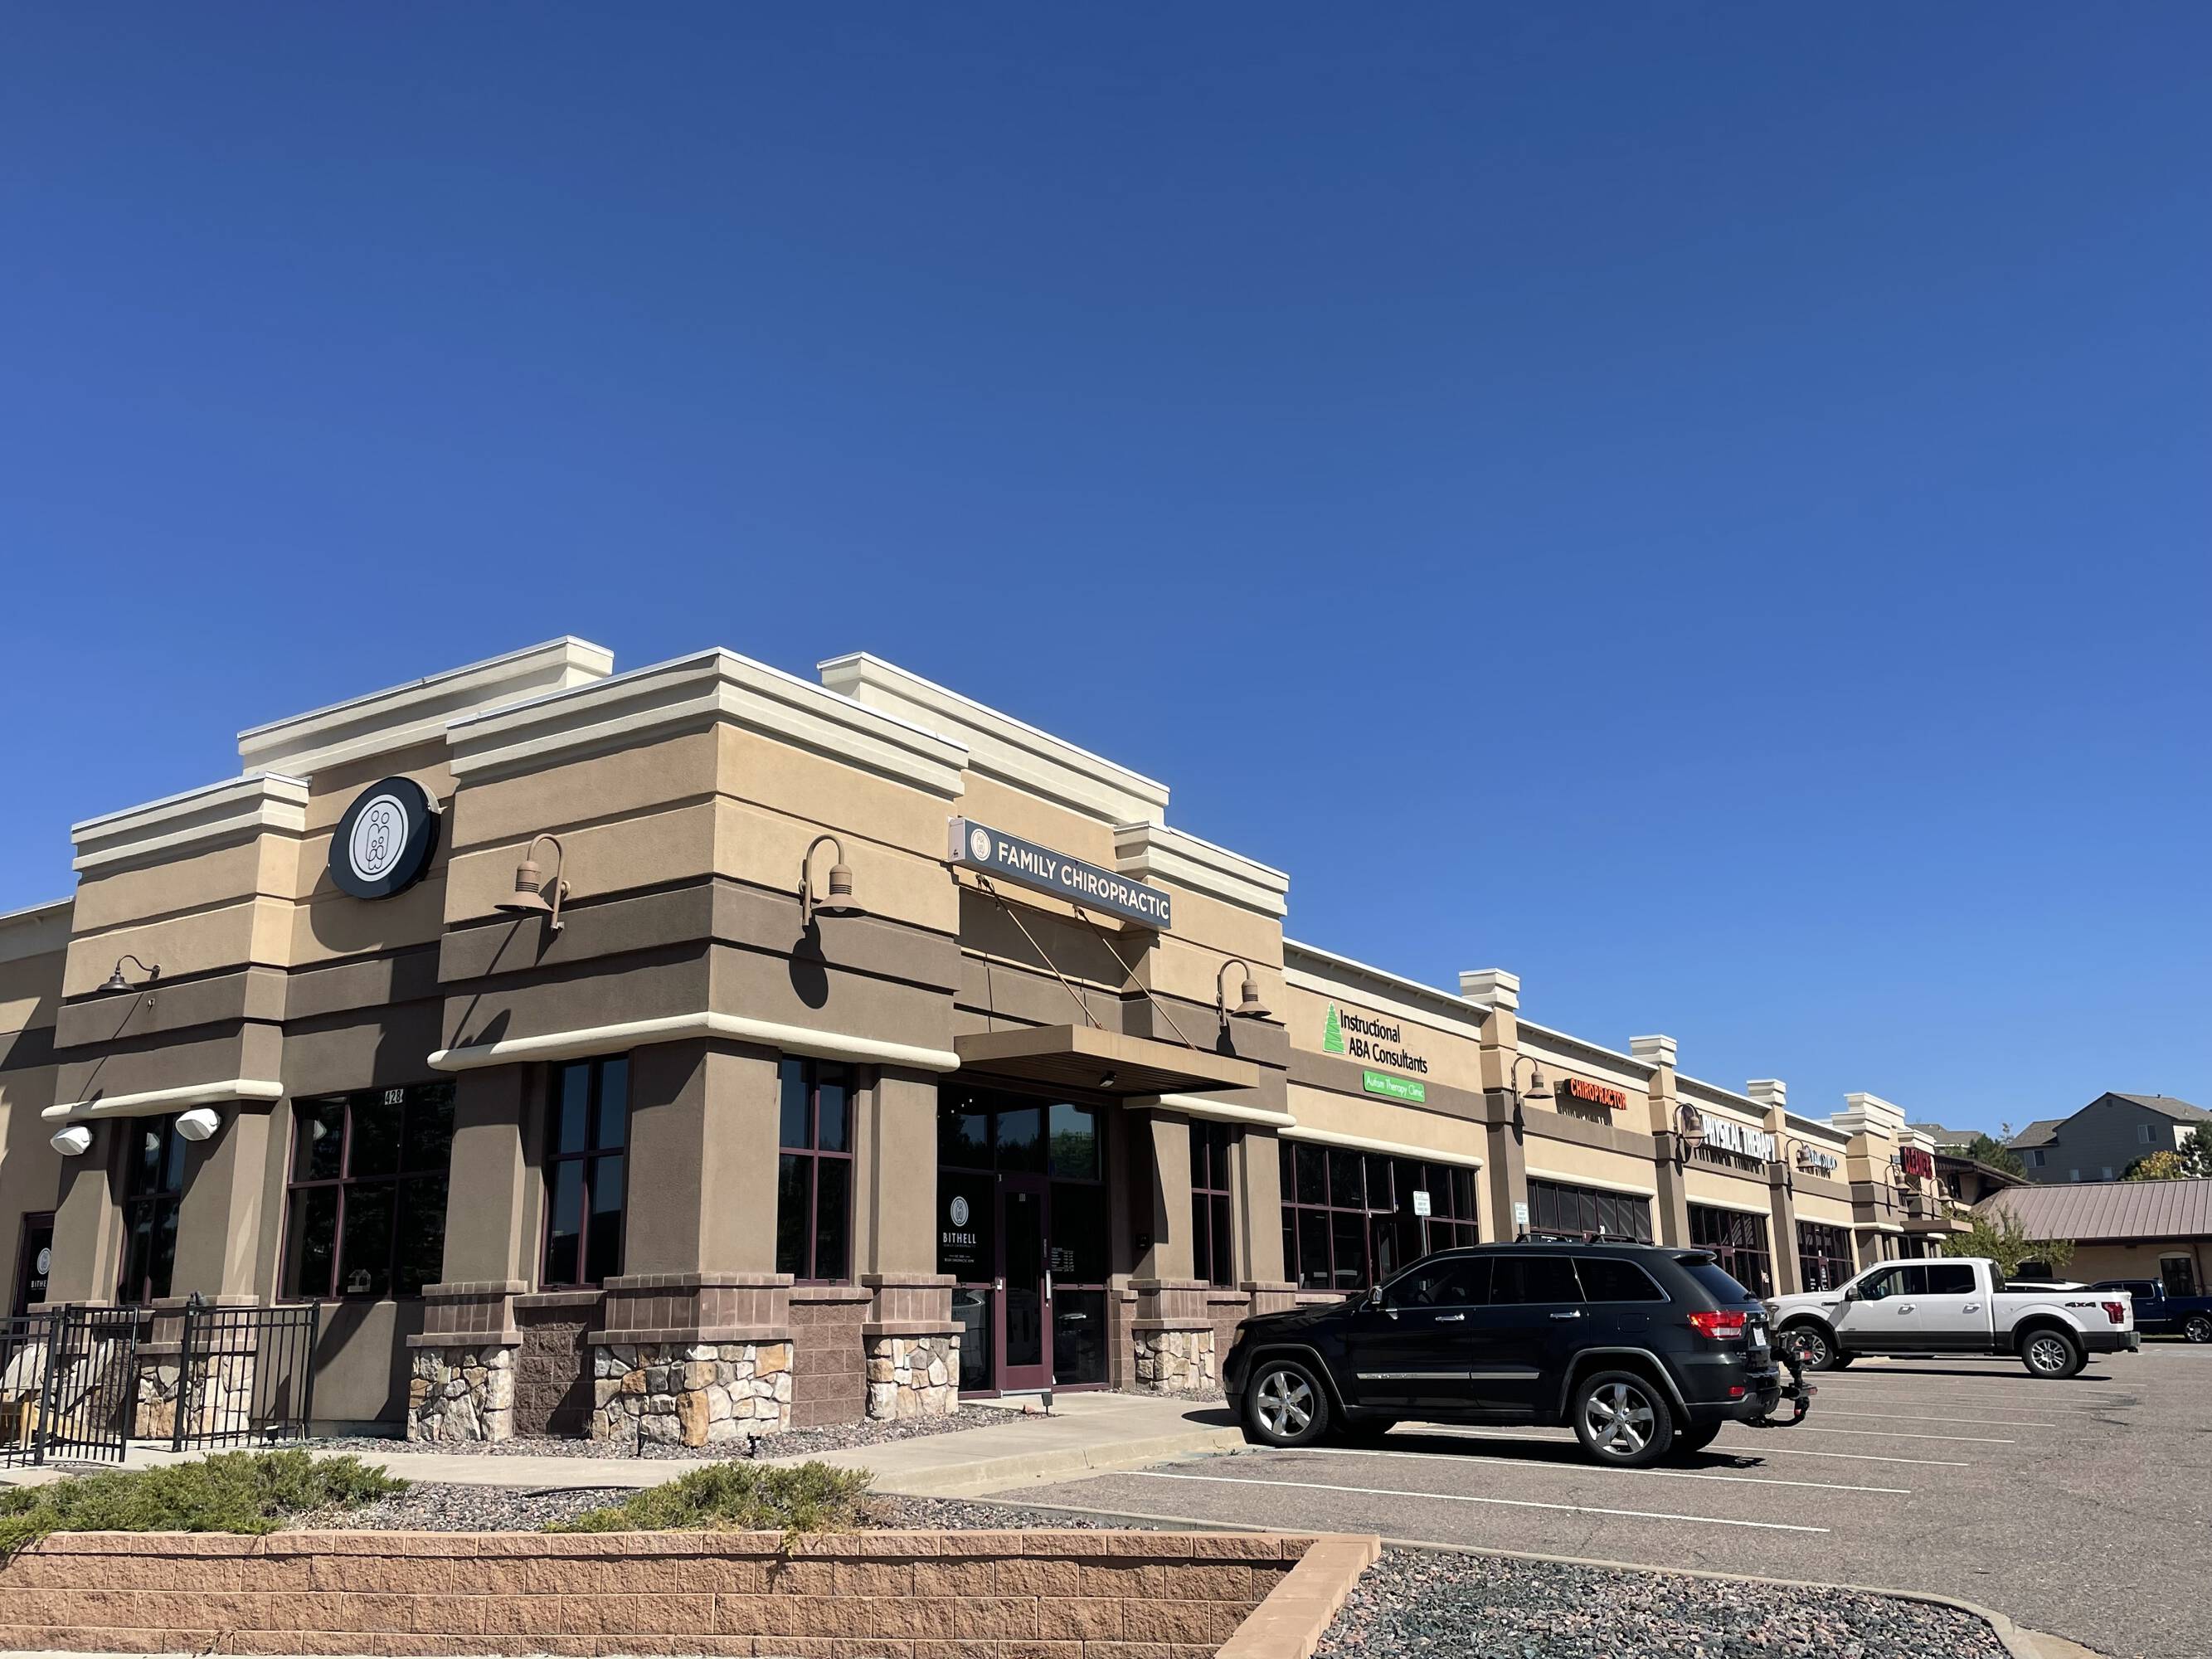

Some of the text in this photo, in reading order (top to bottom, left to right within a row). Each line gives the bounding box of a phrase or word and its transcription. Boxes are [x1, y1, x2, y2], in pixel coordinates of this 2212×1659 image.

[998, 841, 1170, 920] FAMILY CHIROPRACTIC
[1339, 1010, 1401, 1044] Instructional
[1349, 1037, 1428, 1074] ABA Consultants
[385, 1089, 401, 1104] 428
[1366, 1075, 1385, 1089] Autism
[1385, 1078, 1407, 1097] Therapy
[1570, 1078, 1627, 1111] CHIROPRACTOR
[1702, 1114, 1743, 1154] PHYSICAL
[1741, 1127, 1776, 1163] THERAPY
[942, 1232, 977, 1244] BITHELL
[31, 1280, 47, 1288] BITHE
